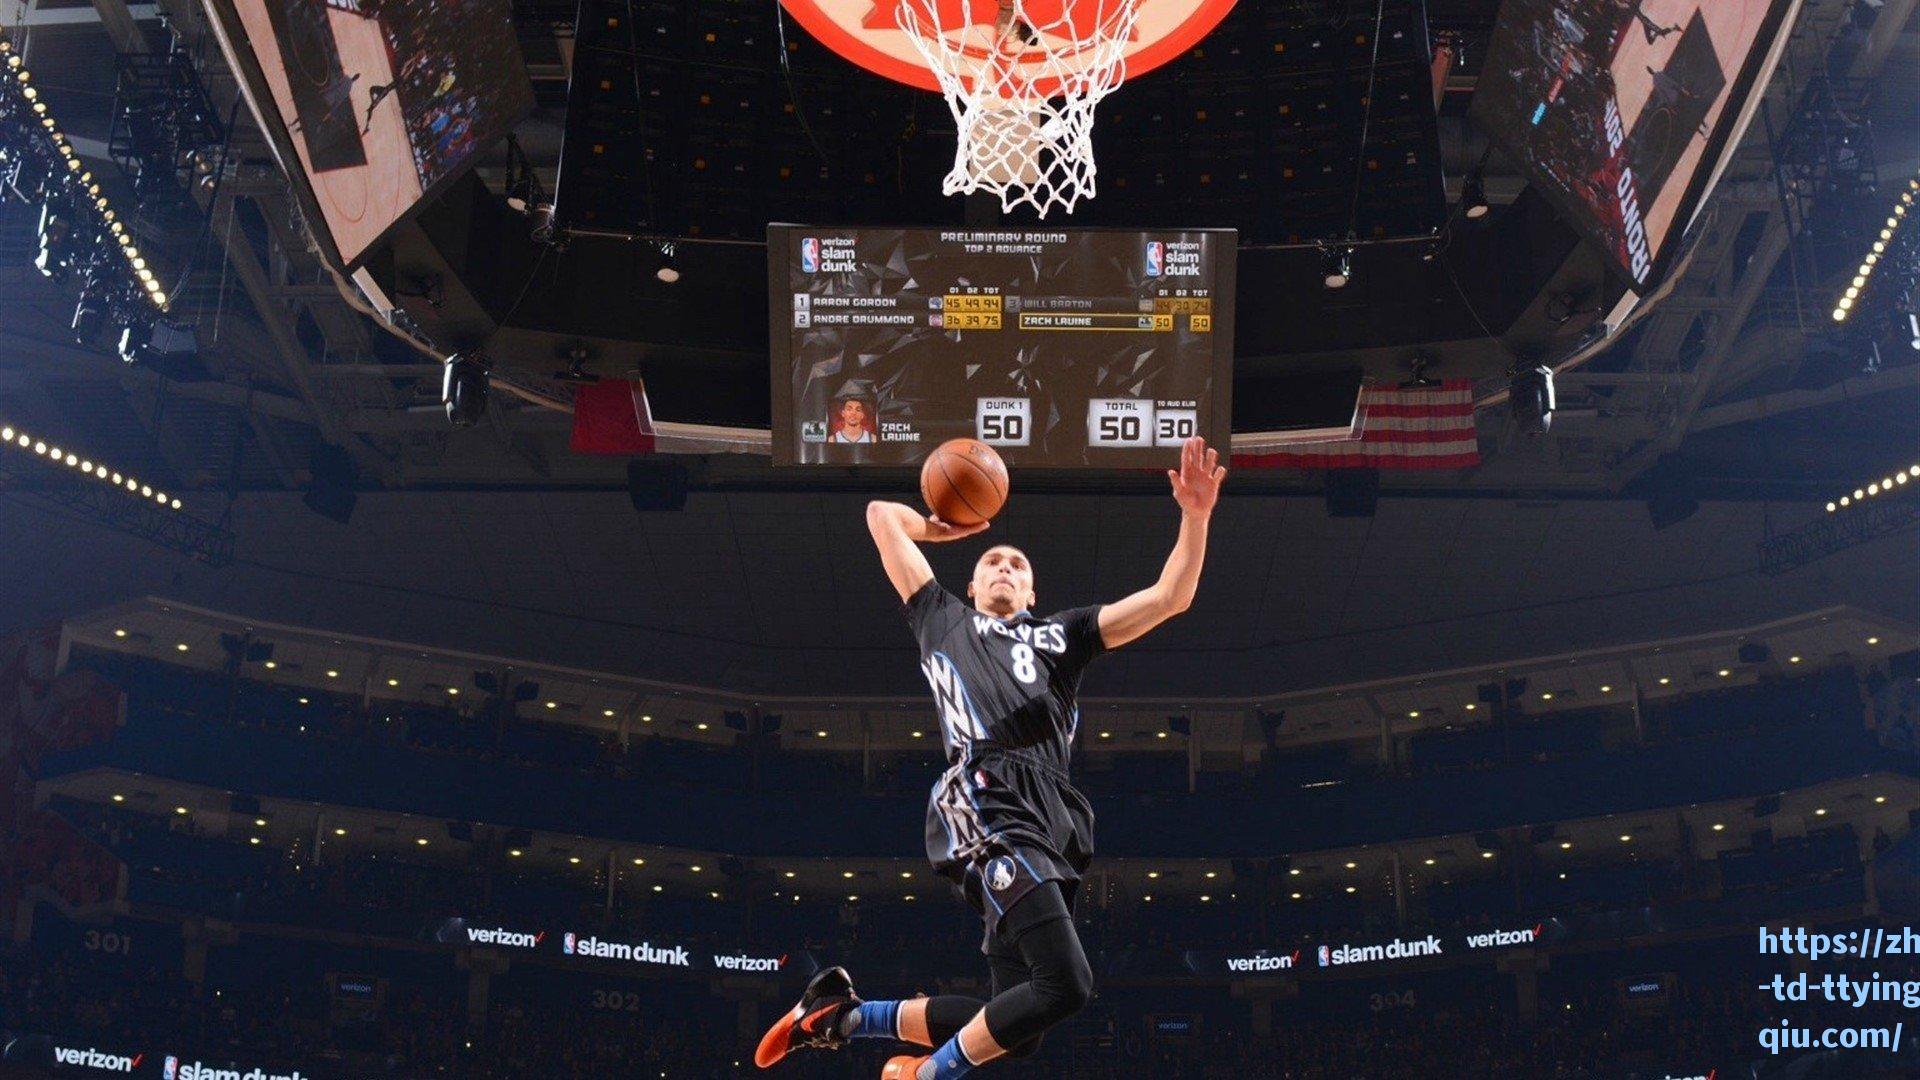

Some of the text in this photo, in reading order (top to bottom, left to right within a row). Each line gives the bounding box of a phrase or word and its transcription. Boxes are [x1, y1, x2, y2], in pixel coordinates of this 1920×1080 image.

[821, 237, 855, 246] verizon
[941, 232, 1067, 243] PRELIMINARY ROUND
[965, 244, 984, 253] TOP
[986, 245, 992, 253] 2
[1166, 241, 1200, 250] verizon
[821, 247, 855, 260] slam
[1165, 250, 1200, 264] slam
[821, 259, 857, 273] dunk
[1164, 264, 1200, 276] dunk
[813, 298, 850, 307] AARON
[853, 298, 897, 307] GORDON
[946, 298, 960, 308] 45
[965, 298, 980, 308] 49
[984, 298, 999, 308] 94
[799, 314, 806, 326] 2
[814, 315, 849, 324] ANDRE
[852, 315, 915, 324] DRUMMOND
[965, 316, 980, 325] 39
[984, 316, 999, 325] 75
[1024, 317, 1052, 325] ZACH
[1156, 318, 1169, 327] 50
[1193, 318, 1208, 327] 50
[986, 401, 1015, 409] DUNK
[1106, 402, 1138, 411] TOTAL
[881, 423, 911, 431] ZACH
[983, 415, 1023, 439] 50
[1100, 416, 1140, 440] 50
[1160, 418, 1193, 438] 30
[1011, 643, 1037, 683] 8
[84, 930, 131, 954] 301
[467, 927, 536, 948] verizon
[1466, 927, 1534, 948] verizon
[577, 936, 689, 966] slam dunk
[1331, 935, 1442, 965] slam dunk
[714, 954, 779, 971] verizon
[1227, 954, 1292, 971] verizon
[341, 982, 372, 993] verizon
[54, 1047, 132, 1072] verizon
